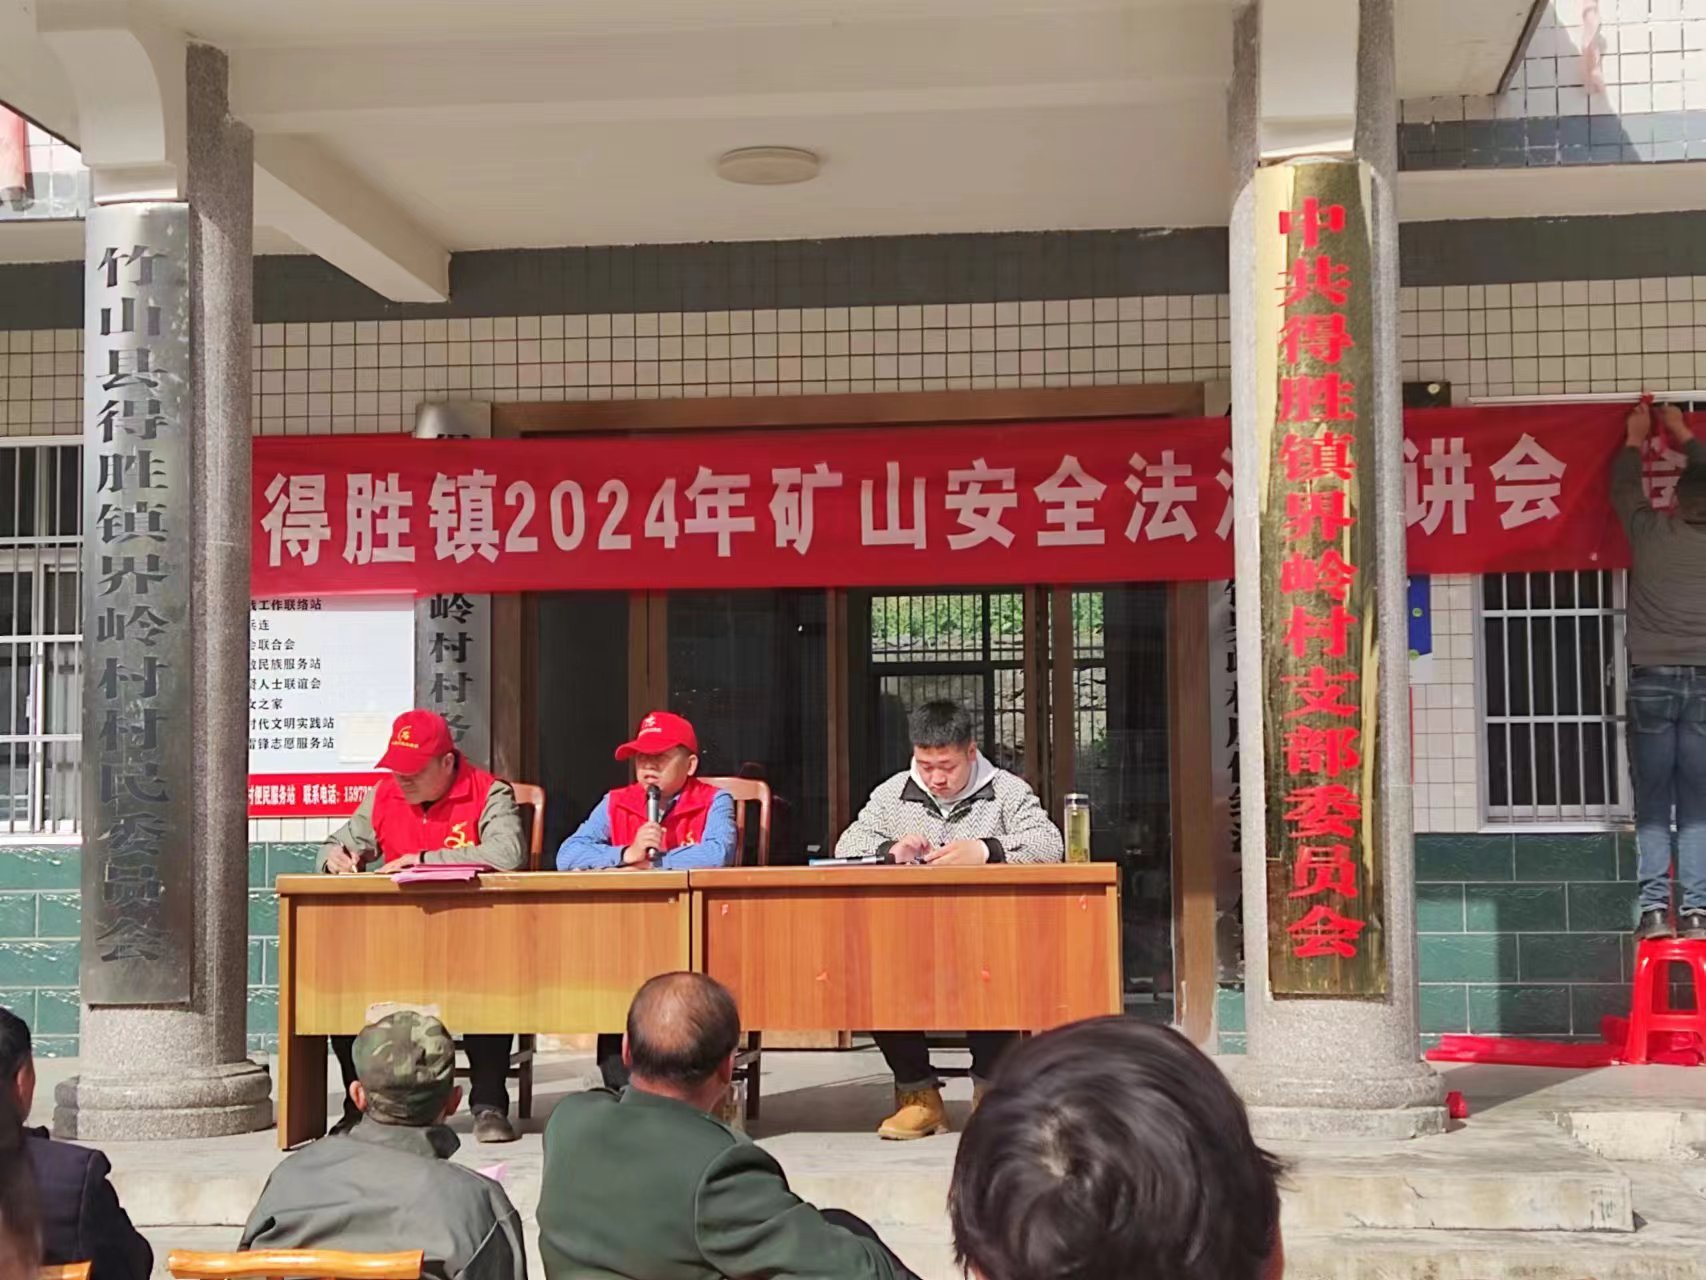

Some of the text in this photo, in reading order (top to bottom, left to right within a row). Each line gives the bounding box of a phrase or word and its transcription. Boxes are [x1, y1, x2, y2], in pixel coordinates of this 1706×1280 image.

[96, 244, 170, 962] 竹山县得胜镇界岭村村民委员会
[260, 432, 1568, 566] 得胜镇2024年矿山安全法讲会
[1275, 196, 1366, 960] 中共得胜镇界岭村支部委员会
